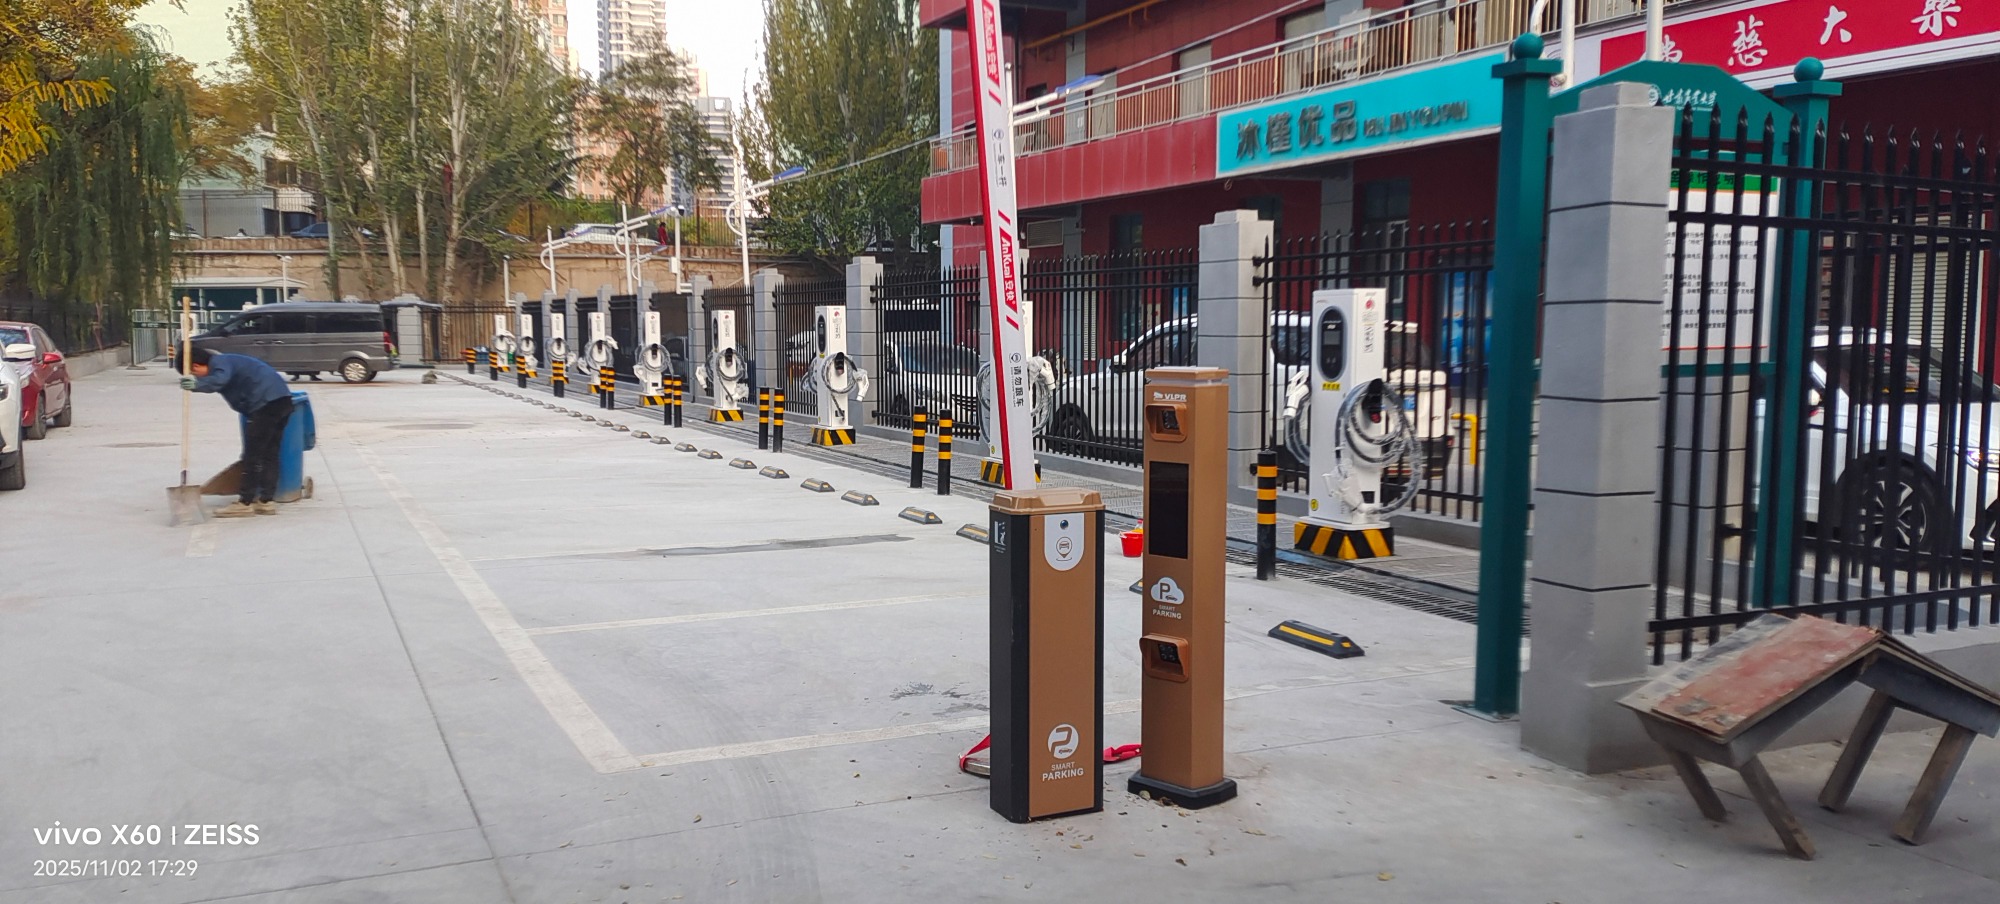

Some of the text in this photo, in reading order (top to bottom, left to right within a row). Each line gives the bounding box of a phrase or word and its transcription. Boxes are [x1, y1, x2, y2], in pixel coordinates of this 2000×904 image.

[1001, 236, 1014, 279] AnKuai
[1014, 366, 1024, 407] 请勿跟车
[1164, 393, 1187, 401] VLPR
[1152, 608, 1182, 620] PARKING
[1051, 761, 1076, 771] SMART
[1042, 767, 1084, 782] PARKING
